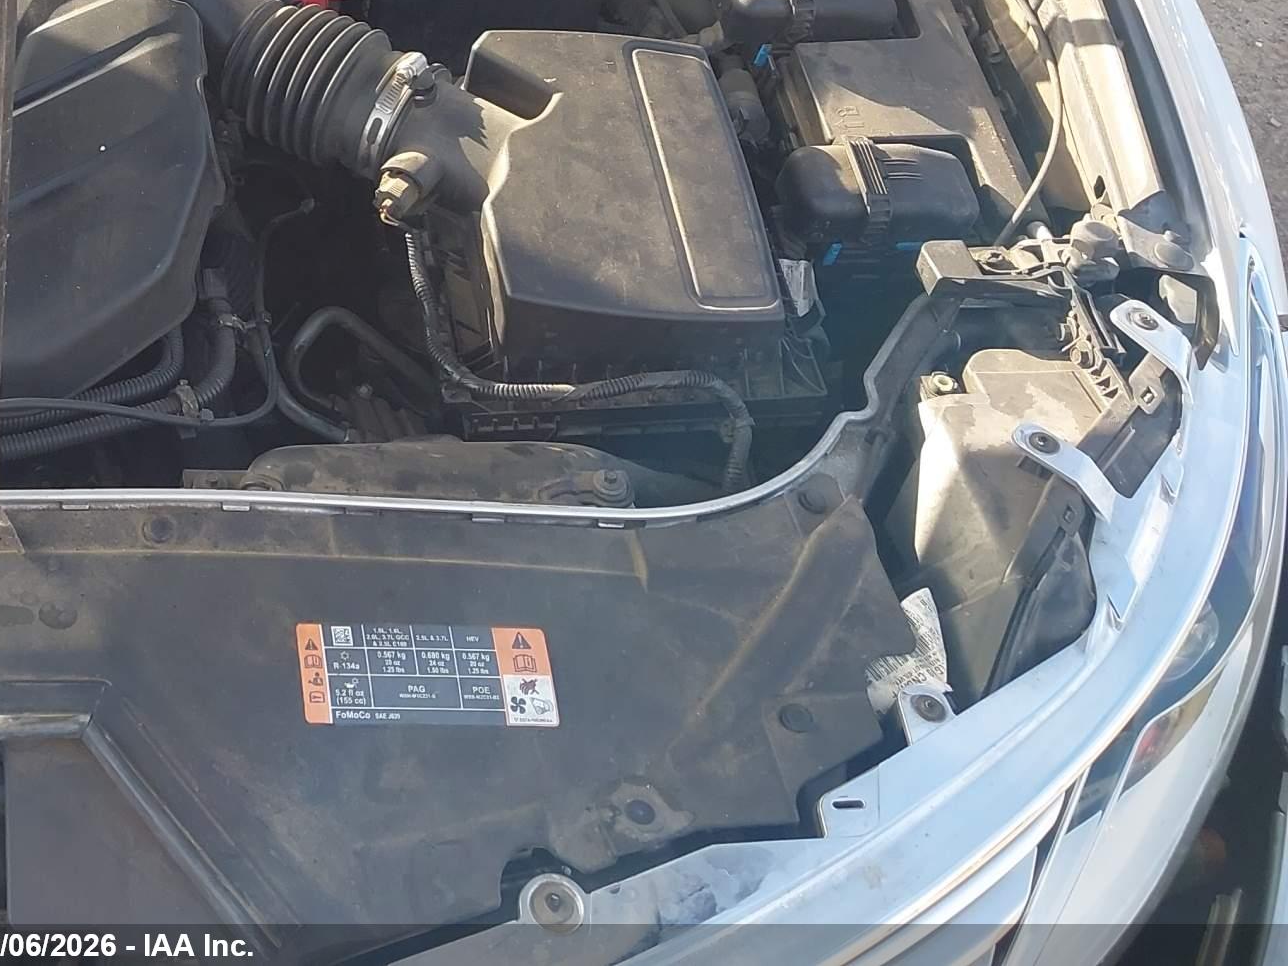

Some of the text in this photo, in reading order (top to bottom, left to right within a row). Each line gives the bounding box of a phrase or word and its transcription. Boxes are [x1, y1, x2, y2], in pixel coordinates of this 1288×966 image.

[396, 651, 406, 660] kg
[440, 652, 450, 661] kg
[481, 653, 490, 662] kg
[335, 688, 347, 697] 5.2
[407, 685, 426, 693] PAG
[472, 686, 491, 694] POE
[336, 697, 367, 706] (155 cc)
[335, 711, 371, 719] FoMoCo
